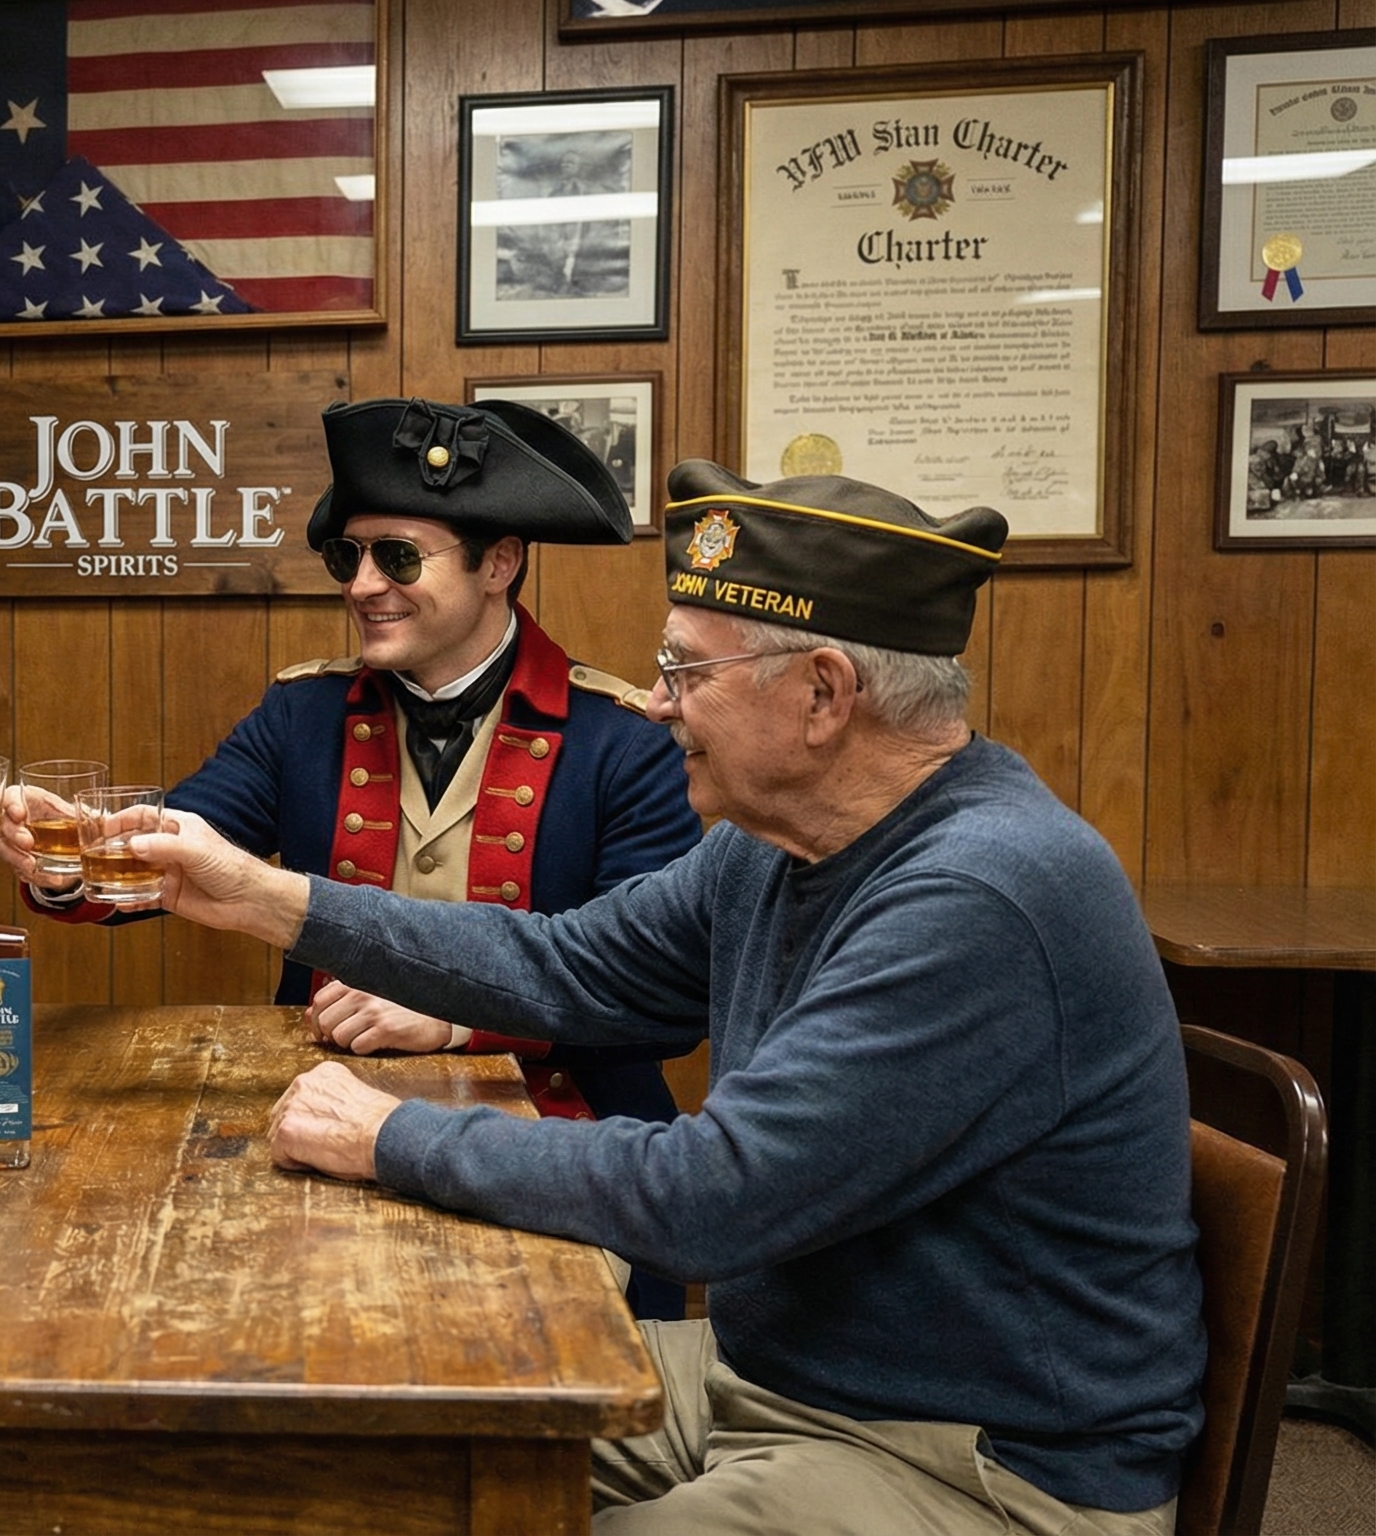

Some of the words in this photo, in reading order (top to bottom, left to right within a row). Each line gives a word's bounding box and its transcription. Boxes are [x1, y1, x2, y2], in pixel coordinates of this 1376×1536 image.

[776, 129, 862, 192] VFW
[952, 117, 1069, 181] Charter
[857, 229, 989, 269] Charter
[28, 415, 231, 502] JOHN
[77, 554, 179, 577] SPIRITS
[715, 579, 814, 620] VETERAN
